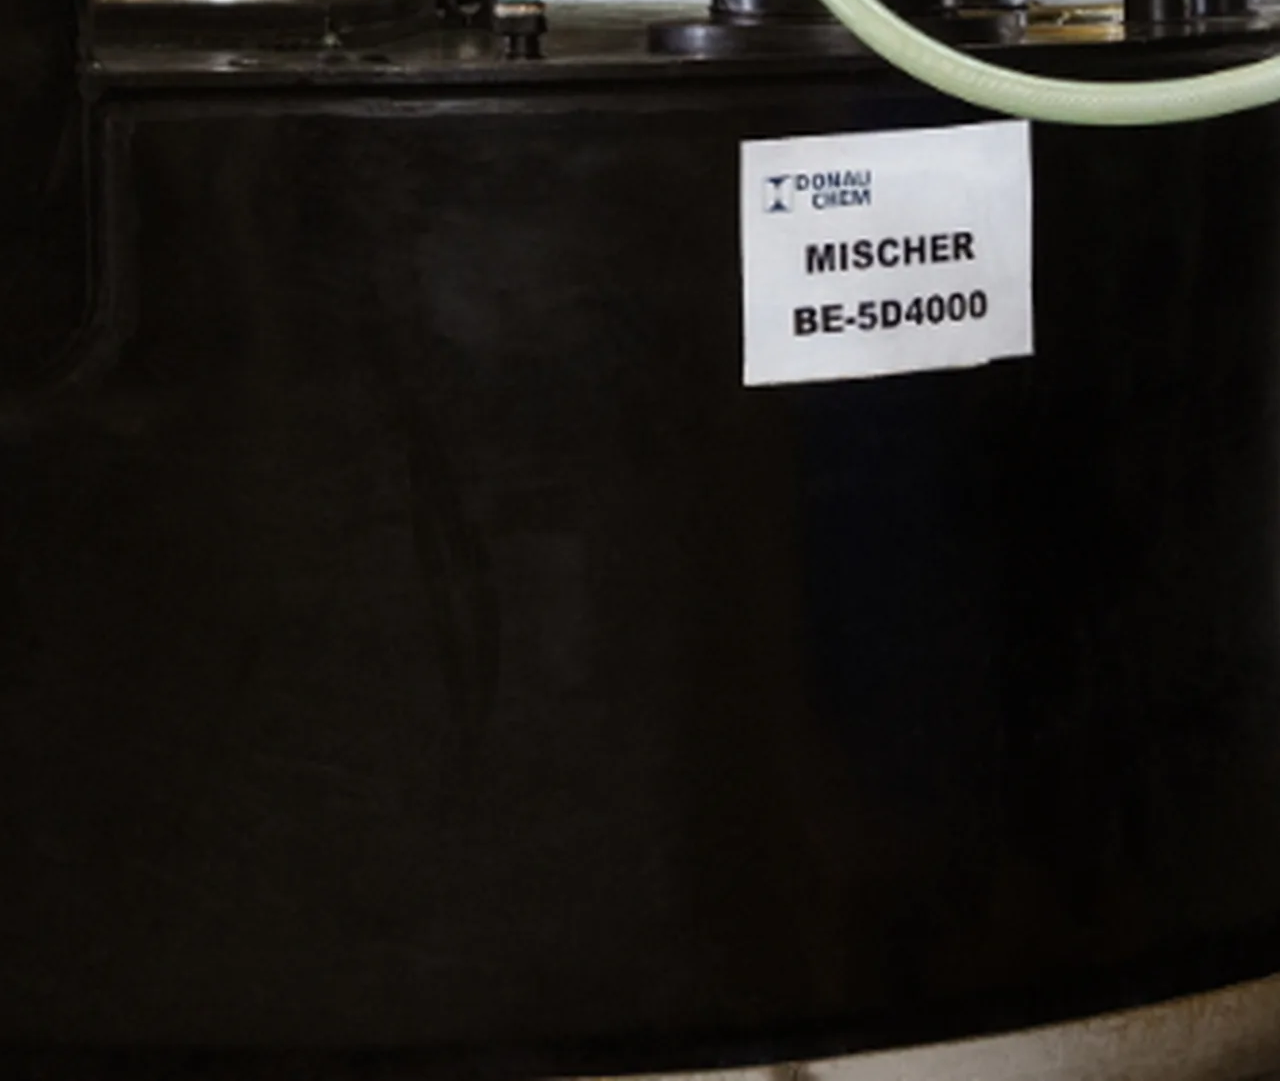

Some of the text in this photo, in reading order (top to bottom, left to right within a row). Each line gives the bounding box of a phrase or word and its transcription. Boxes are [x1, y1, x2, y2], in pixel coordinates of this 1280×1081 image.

[795, 171, 871, 191] DONAU
[811, 190, 871, 209] CHEM
[805, 231, 976, 275] MISCHER
[793, 289, 989, 337] BE-5D4000
